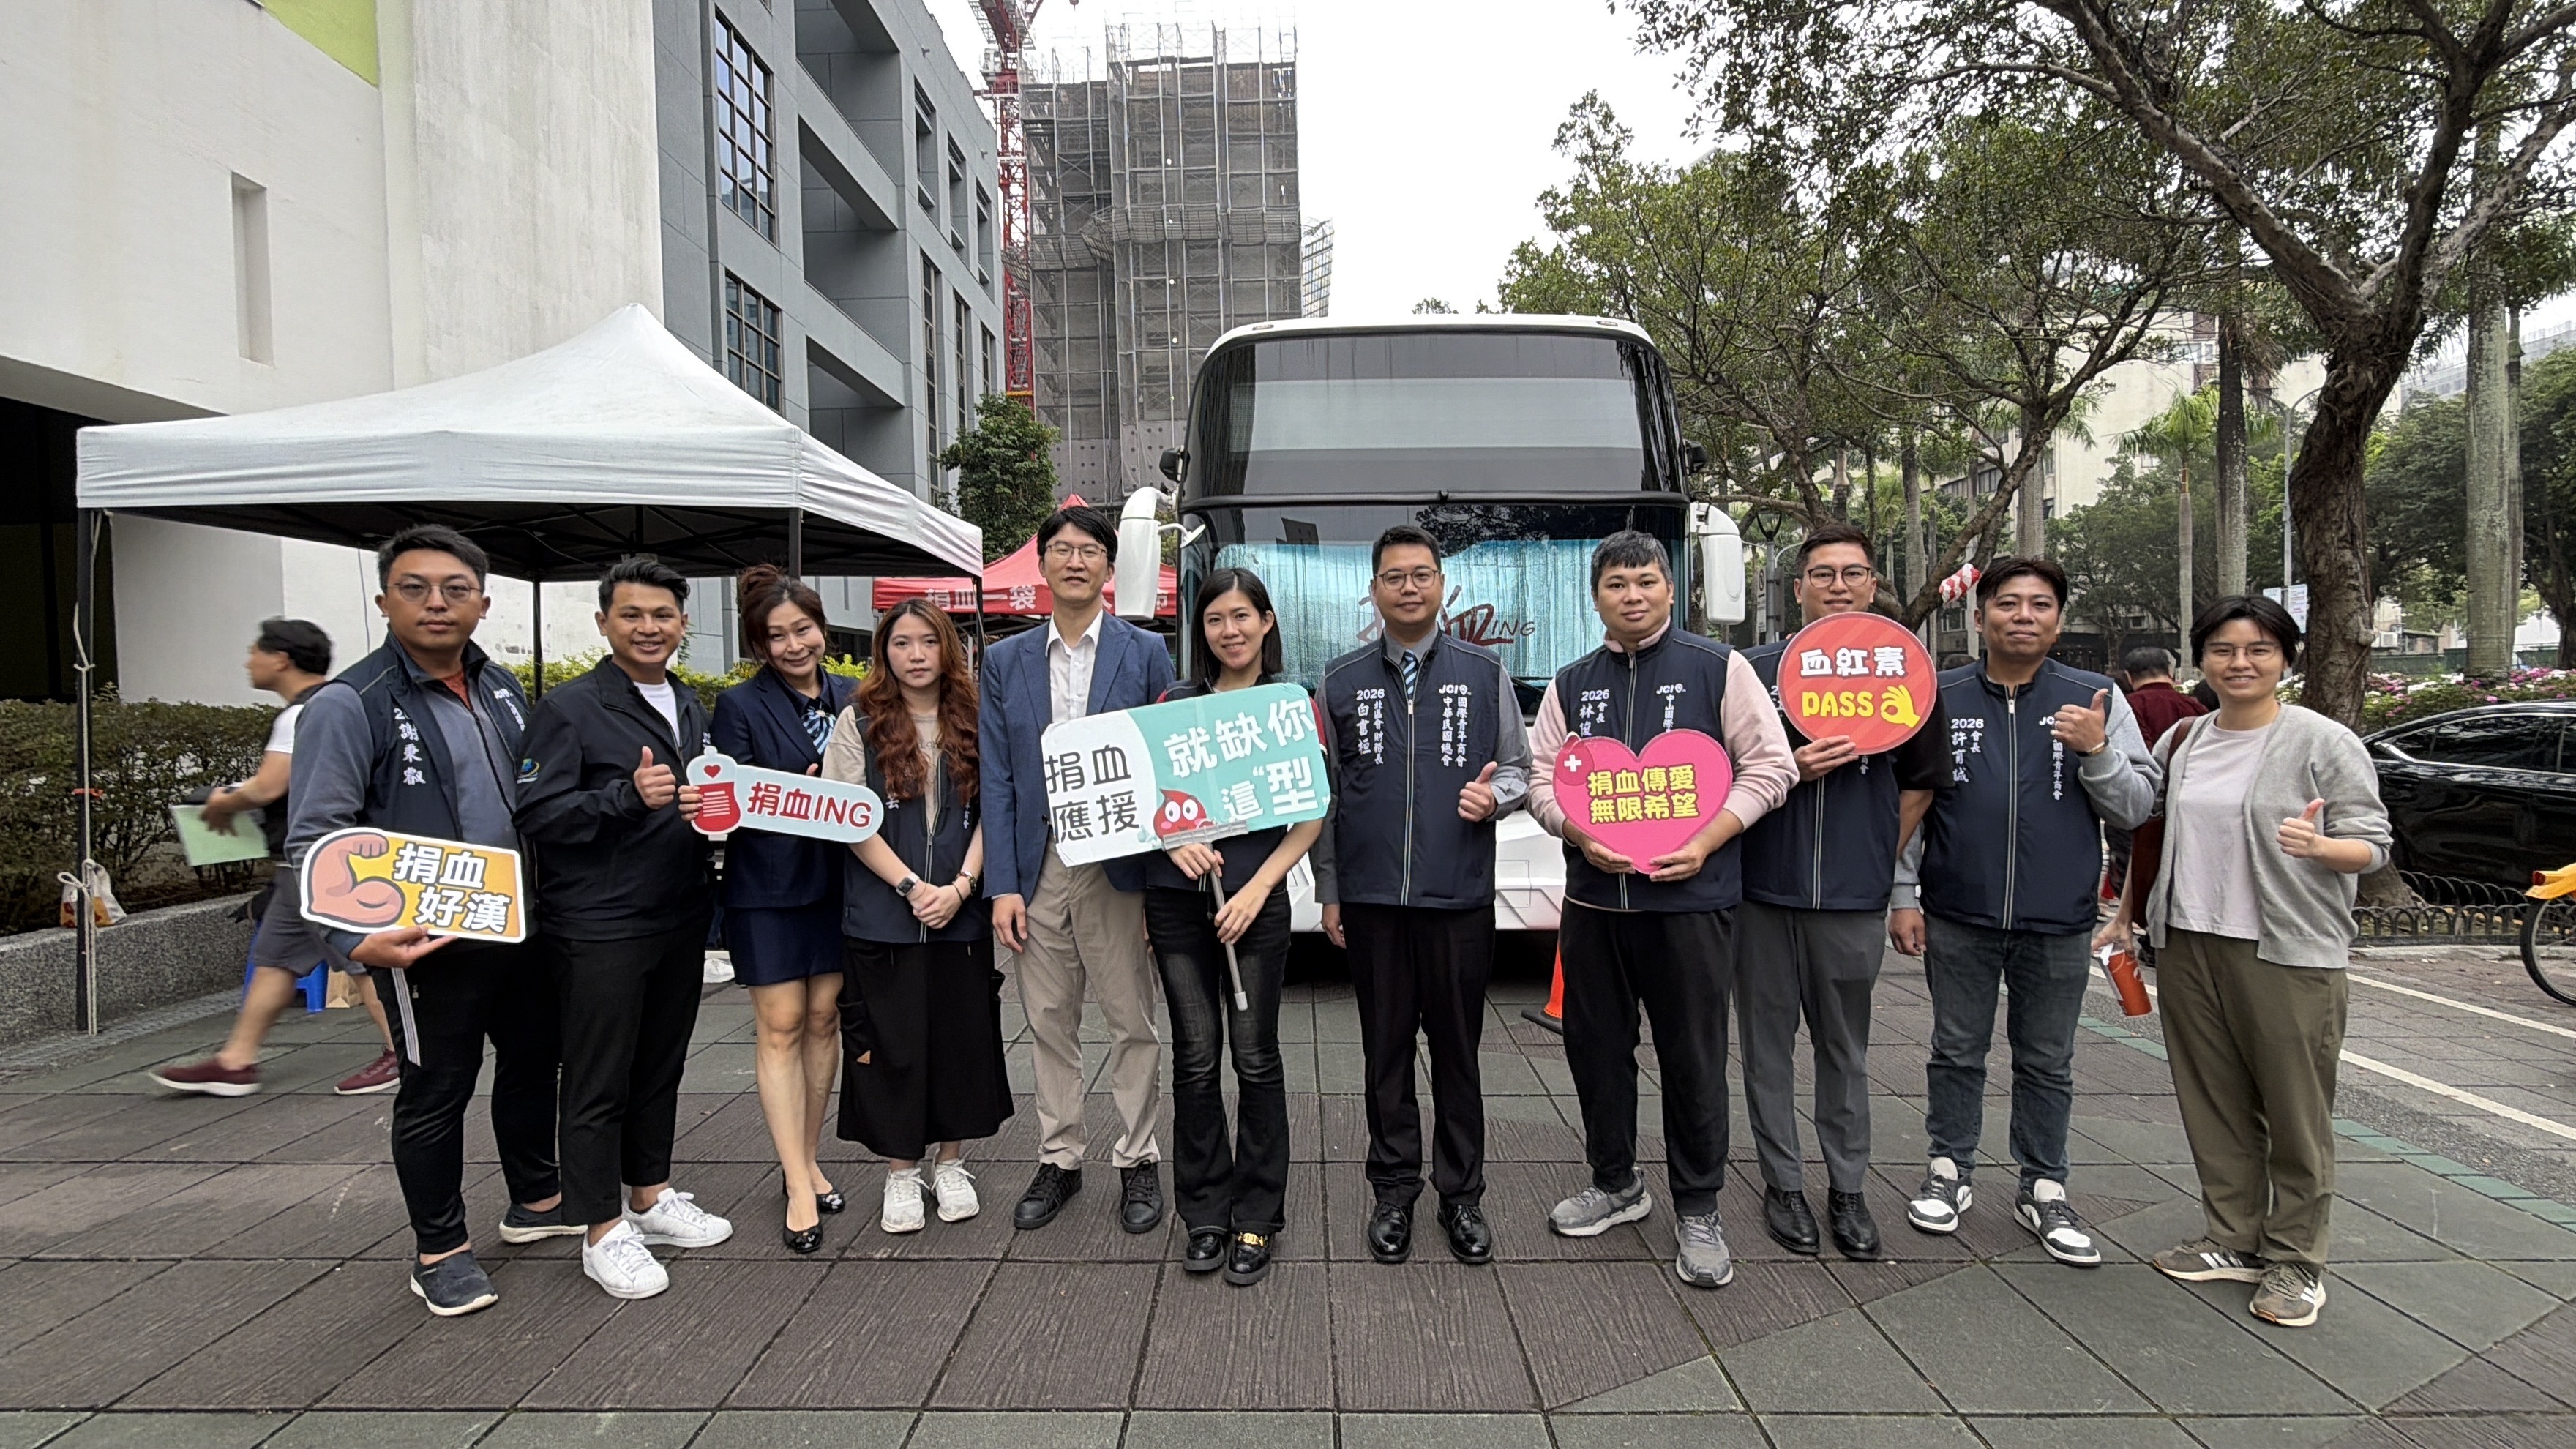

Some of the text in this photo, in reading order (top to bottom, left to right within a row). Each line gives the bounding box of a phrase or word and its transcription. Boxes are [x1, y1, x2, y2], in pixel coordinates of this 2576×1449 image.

[924, 585, 1036, 611] 捐血一袋
[1800, 646, 1906, 676] 血紅素
[1356, 689, 1385, 700] 2026
[1581, 689, 1610, 702] 2026
[1802, 691, 1874, 718] PASS
[1663, 694, 1674, 733] 中山國際
[1950, 718, 1984, 729] 2026
[2039, 716, 2055, 726] JC
[1163, 698, 1316, 779] 就缺你
[1970, 730, 1983, 753] 會長
[1044, 744, 1132, 795] 捐血
[1587, 764, 1696, 797] 捐血傳愛
[2052, 738, 2064, 801] 國際青年商會
[747, 781, 872, 828] 捐血ING
[1052, 790, 1140, 845] 應援
[1590, 792, 1699, 824] 無限希望
[394, 842, 485, 889] 捐血
[415, 886, 511, 933] 好漢
